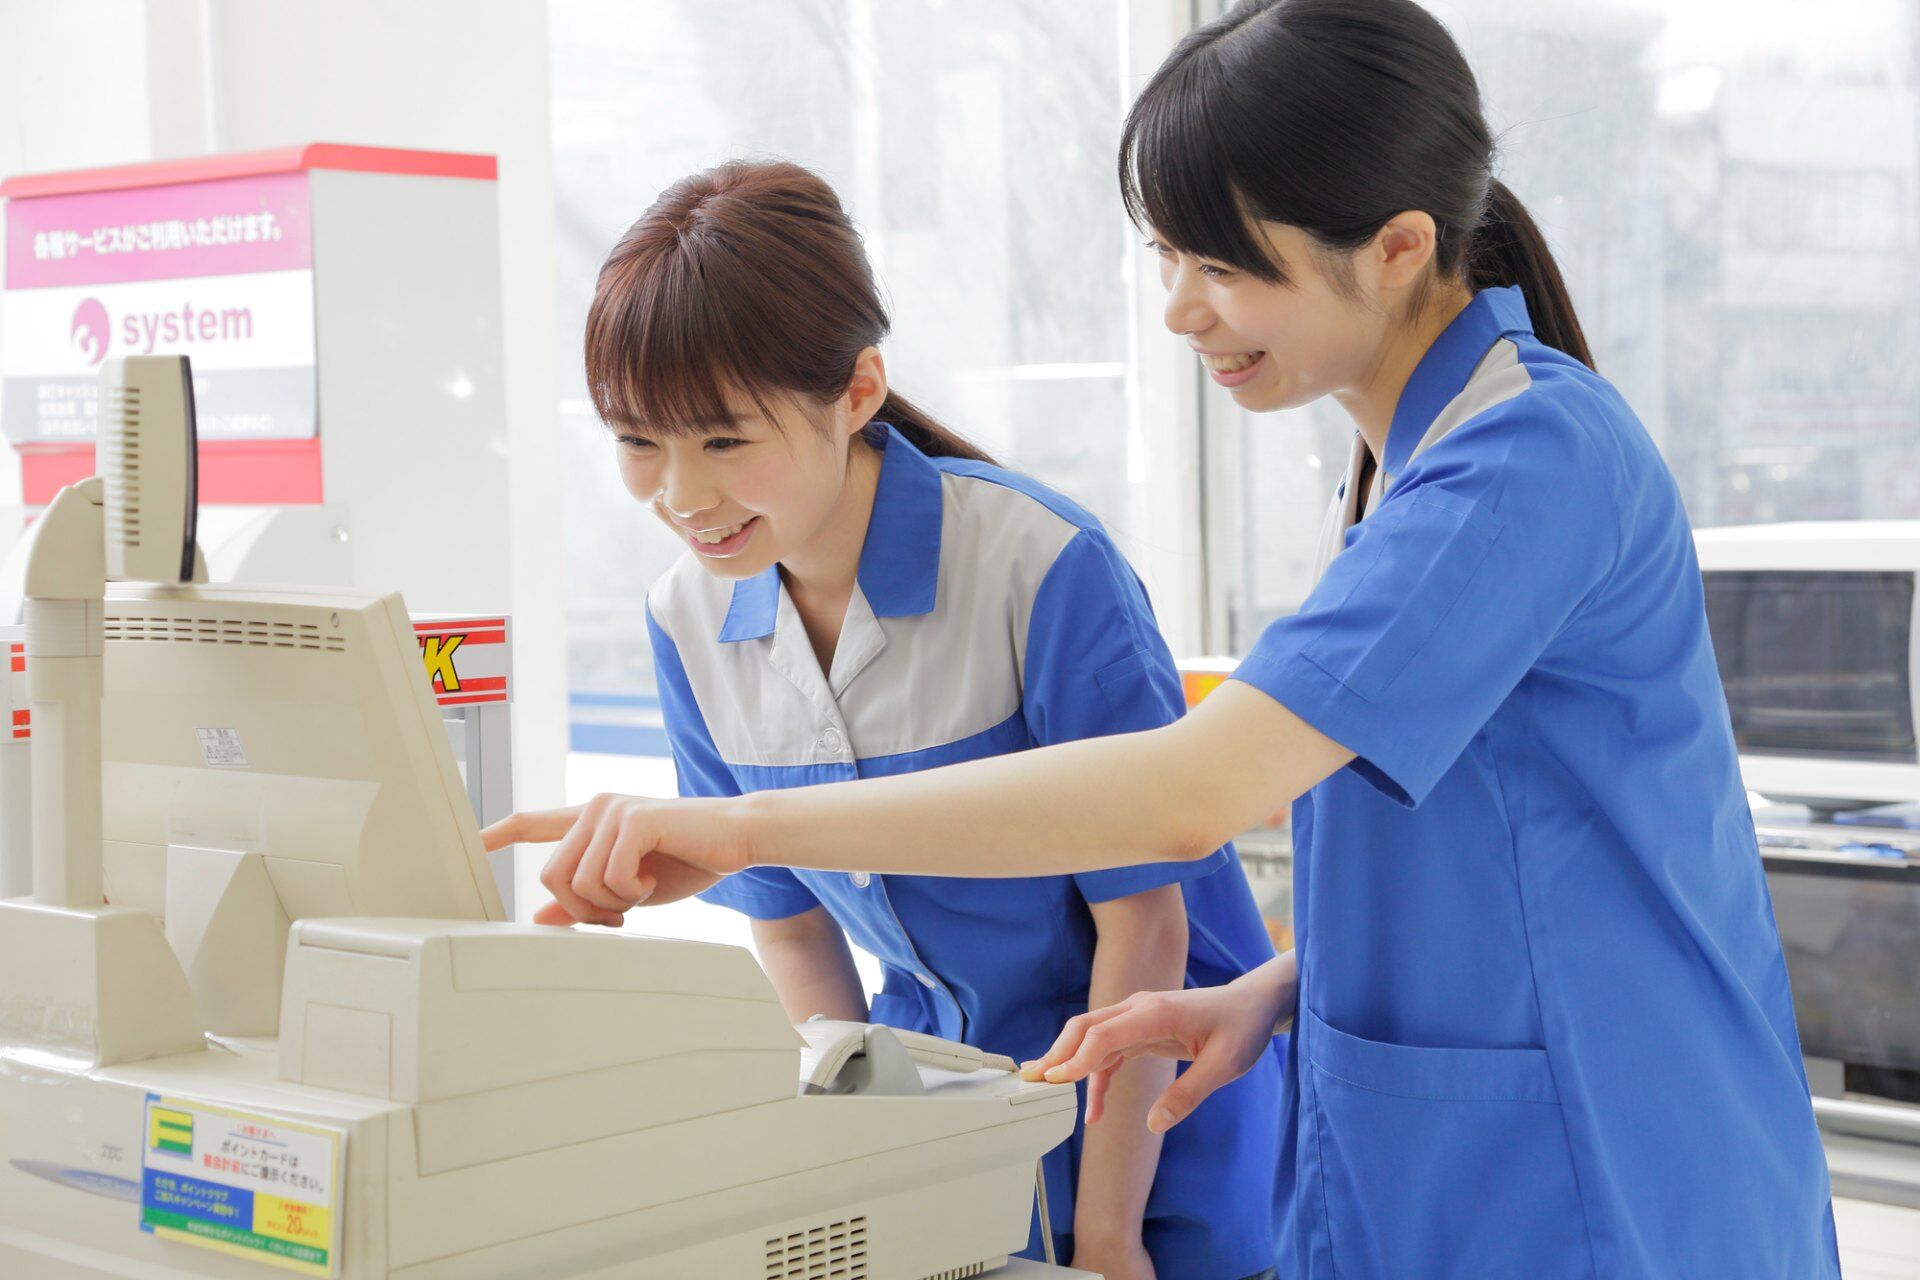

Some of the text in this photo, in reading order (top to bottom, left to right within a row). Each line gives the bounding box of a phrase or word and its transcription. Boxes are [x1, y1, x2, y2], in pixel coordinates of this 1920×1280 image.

[34, 211, 281, 260] 各種サービスがご利用いただけます。
[123, 302, 252, 354] system
[418, 634, 468, 692] K
[221, 1141, 298, 1168] ポイントカードは
